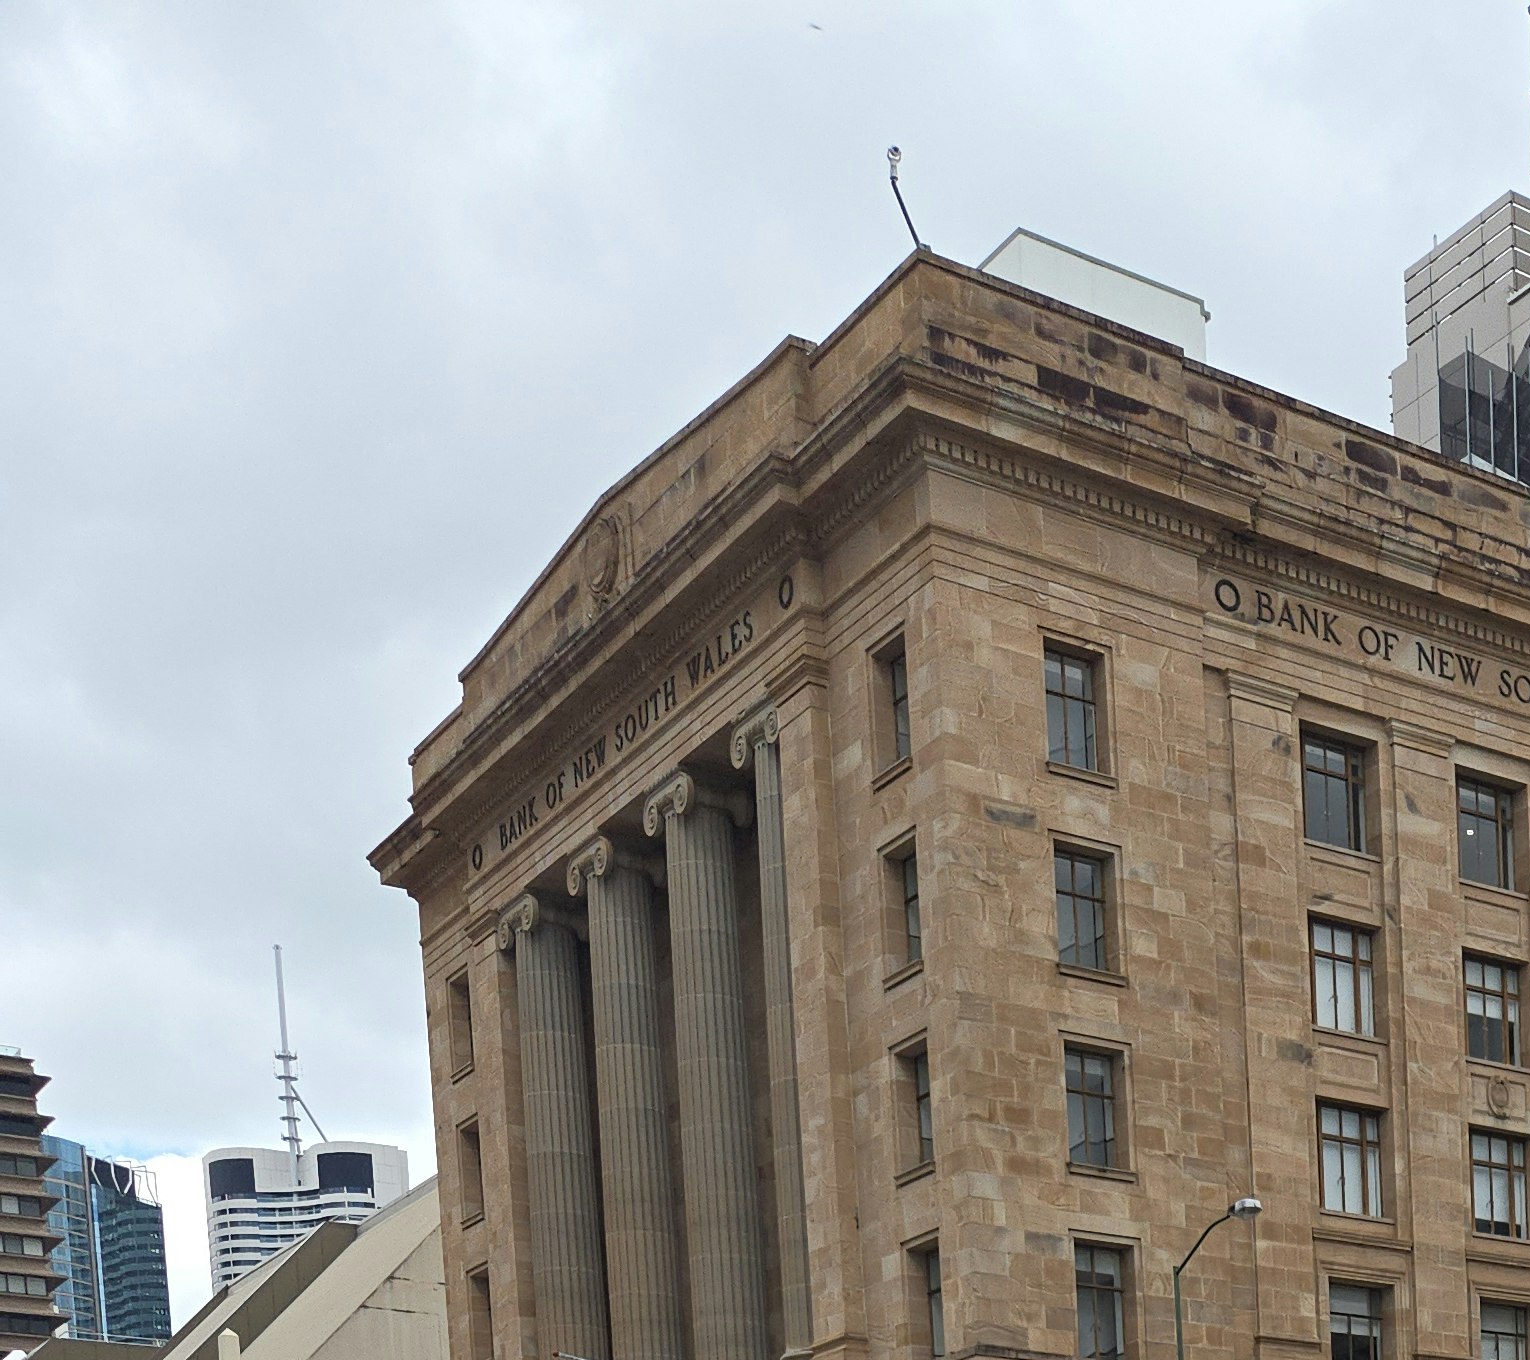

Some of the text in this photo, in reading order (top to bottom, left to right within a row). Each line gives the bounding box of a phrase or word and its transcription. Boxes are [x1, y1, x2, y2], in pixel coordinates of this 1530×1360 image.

[1255, 590, 1343, 646] BANK
[1358, 625, 1400, 661] OF
[1415, 641, 1483, 687] NEW
[500, 796, 539, 851] BANK
[546, 771, 566, 809] OF
[573, 735, 607, 788] NEW
[615, 674, 678, 752] SOUTH
[686, 610, 753, 688] WALES
